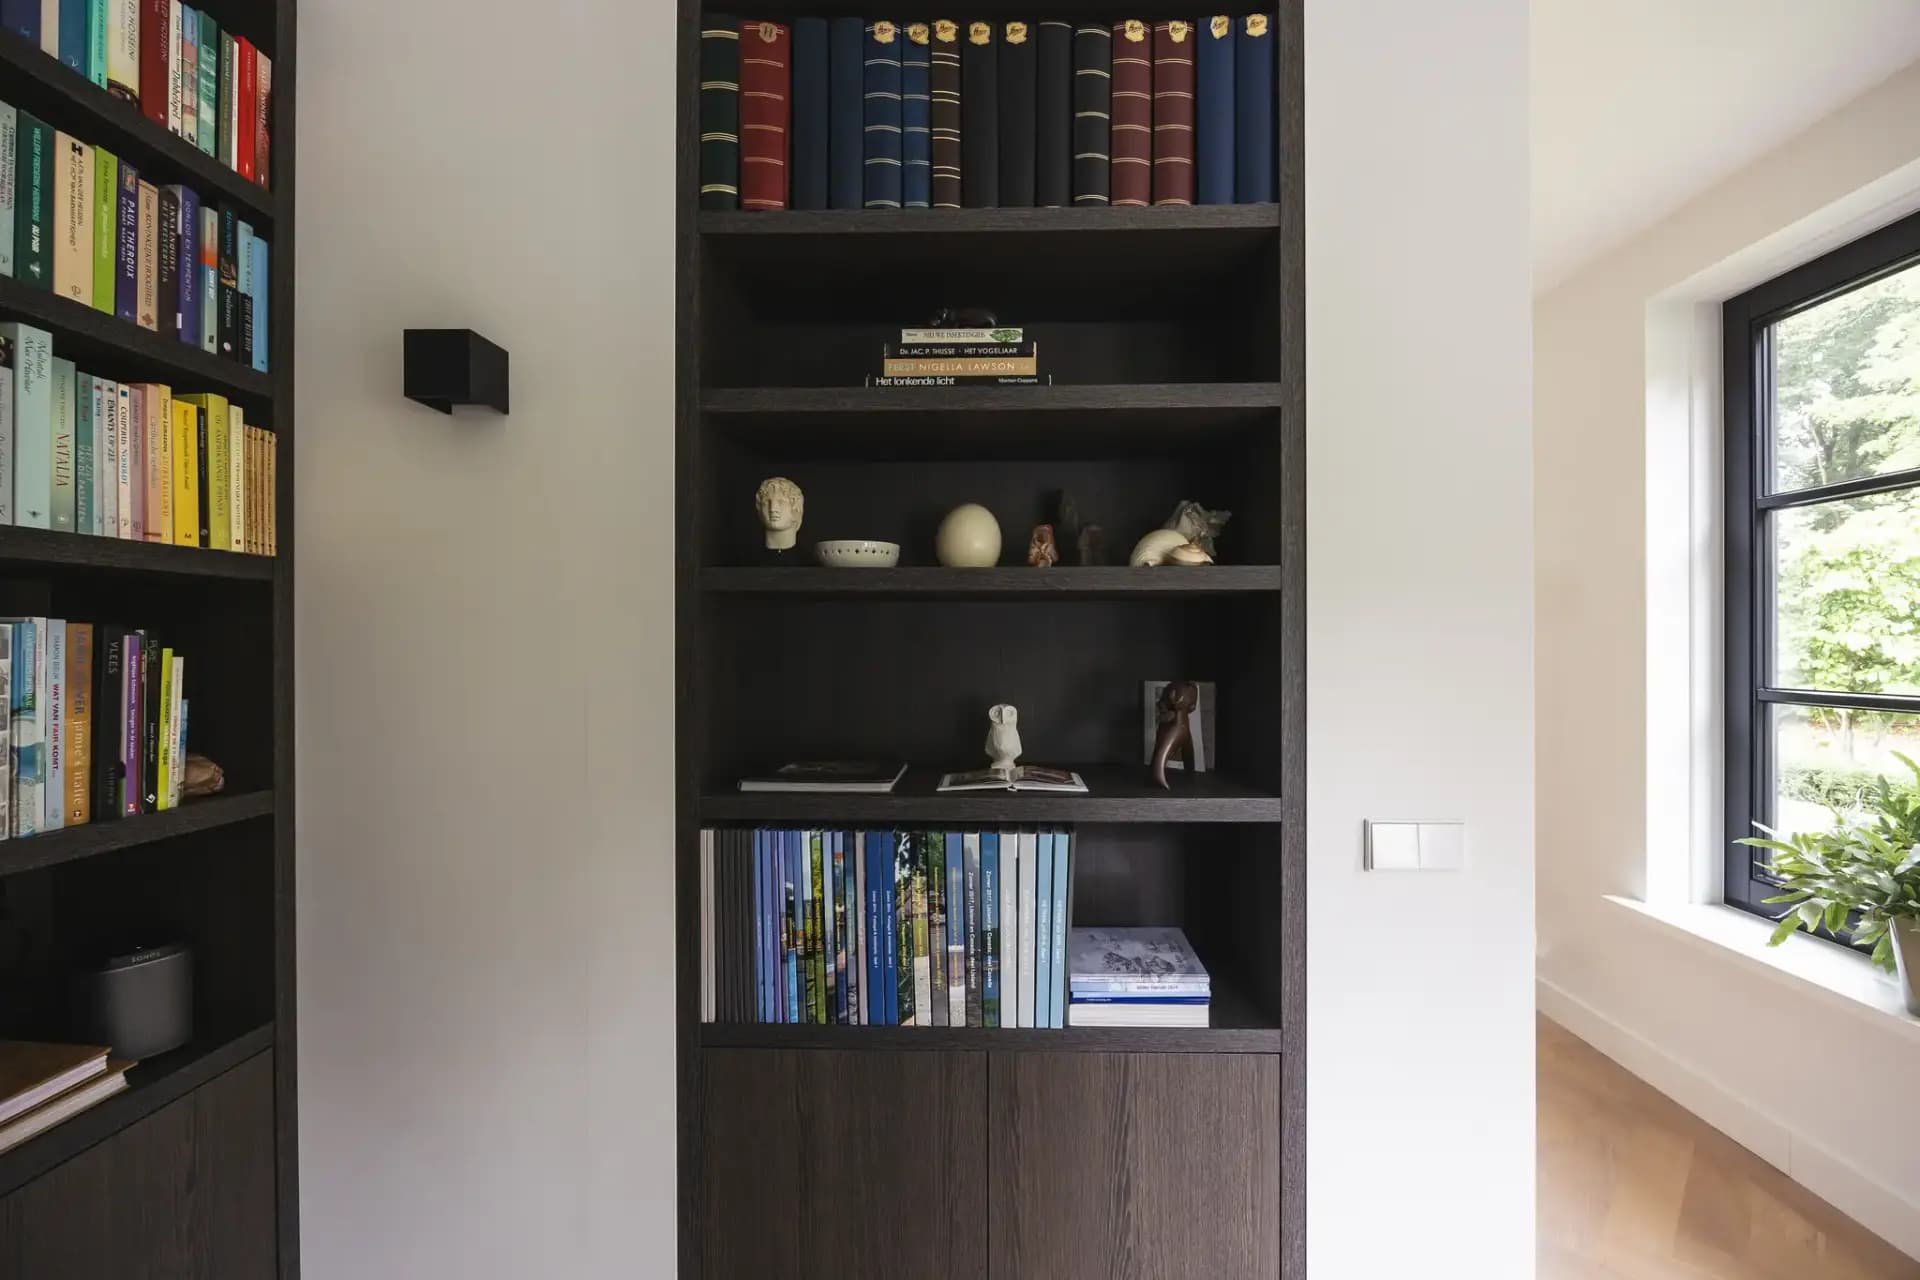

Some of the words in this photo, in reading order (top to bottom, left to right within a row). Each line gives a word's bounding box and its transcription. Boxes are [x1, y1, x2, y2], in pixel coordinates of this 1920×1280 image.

[128, 16, 136, 61] HOSSEINI
[171, 71, 181, 119] Dubbelspel
[32, 127, 41, 155] WILLEM
[127, 199, 135, 226] PAUL
[127, 231, 135, 280] THEROUX
[36, 339, 47, 380] Multatuli
[917, 362, 961, 372] NIGELLA
[966, 362, 1015, 371] LAWSON
[963, 347, 976, 355] HET
[976, 347, 1018, 355] VOGELJAAR
[876, 376, 892, 386] Het
[893, 375, 935, 385] lonkende
[936, 375, 955, 385] licht
[107, 399, 116, 432] EMANTS
[55, 431, 71, 488] NATALIA
[121, 447, 129, 487] NOODLOT
[109, 640, 119, 673] VLEES
[52, 680, 60, 700] WAT
[52, 700, 60, 719] VAN
[52, 720, 60, 742] FAIR
[72, 718, 88, 766] jamie's
